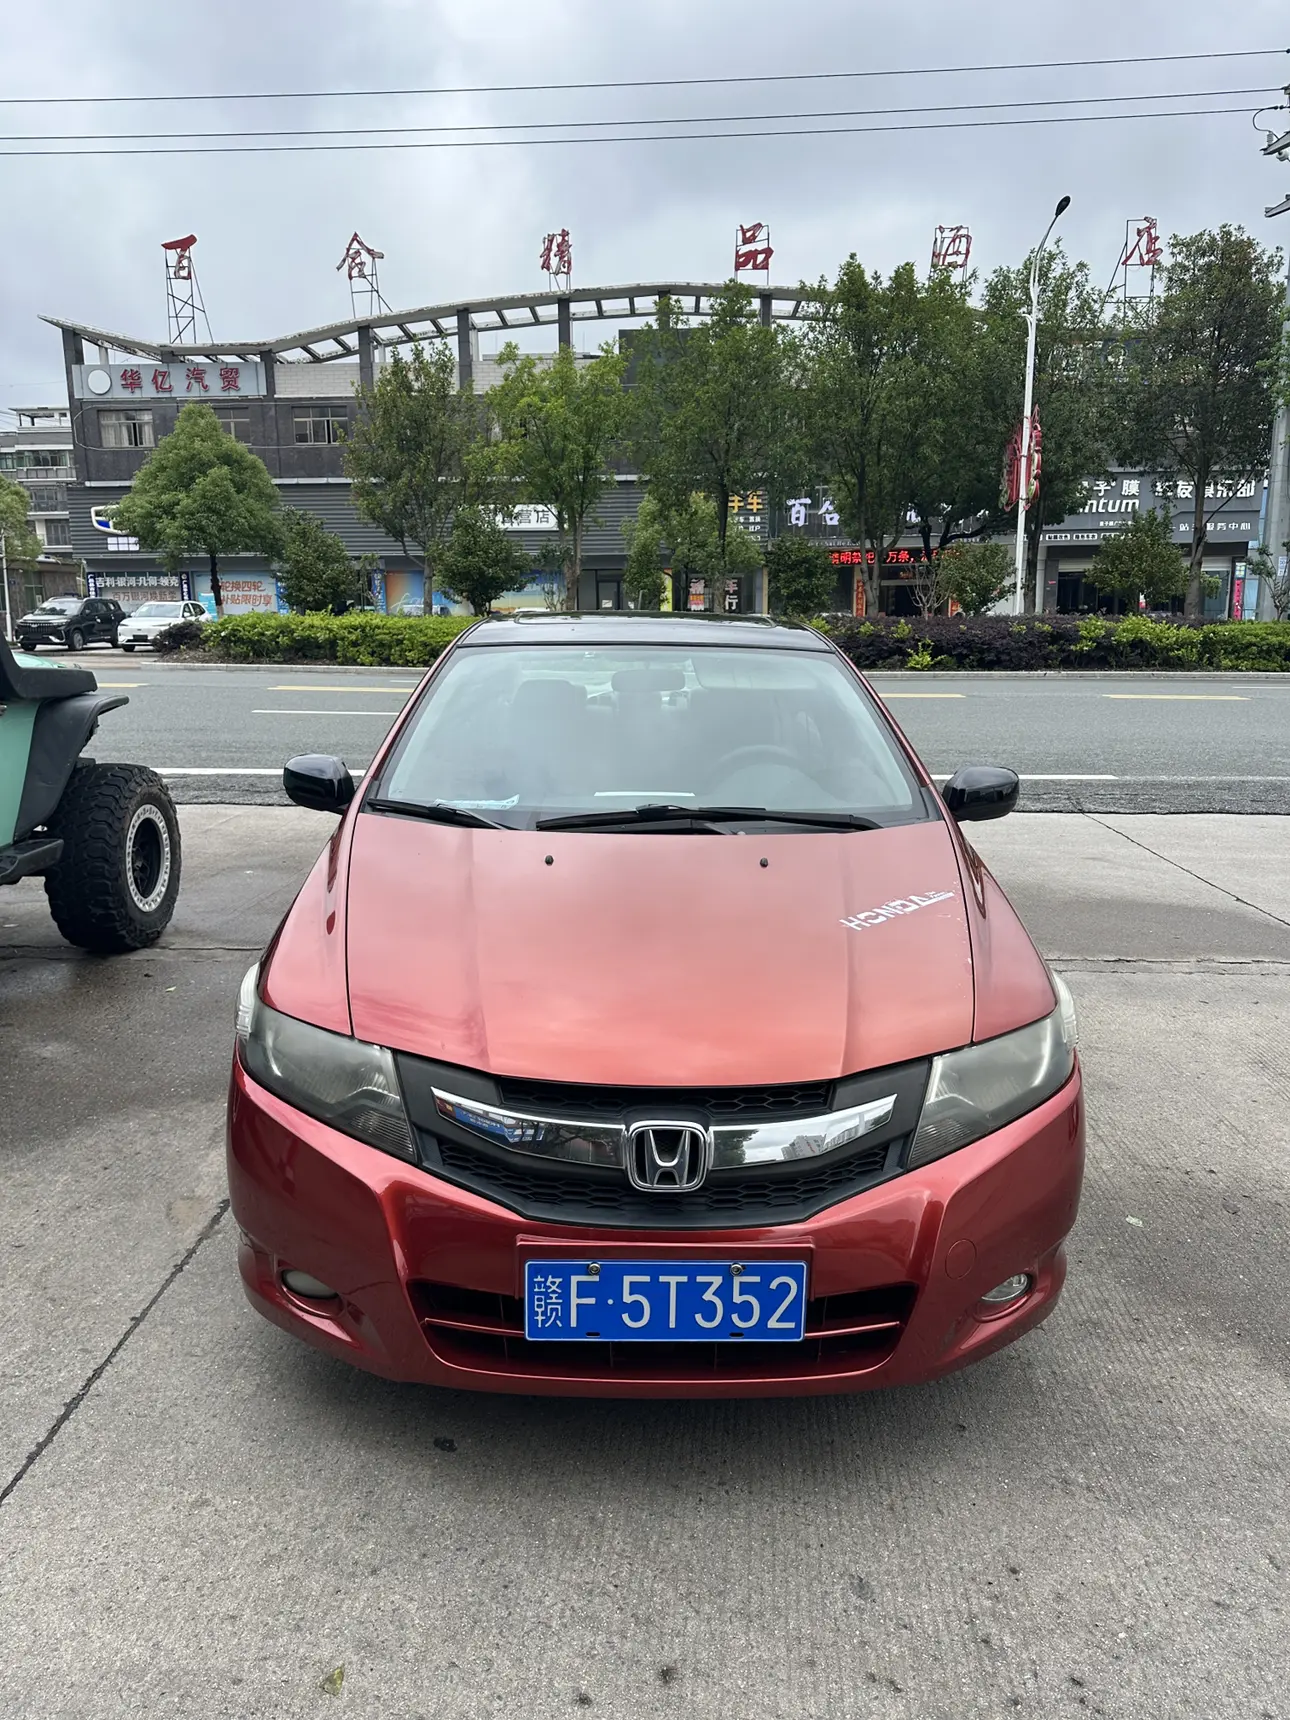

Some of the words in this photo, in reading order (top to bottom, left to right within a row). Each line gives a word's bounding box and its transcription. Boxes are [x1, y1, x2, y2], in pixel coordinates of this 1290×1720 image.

[540, 228, 572, 275] 精
[735, 222, 774, 271] 品
[1122, 216, 1163, 266] 店
[120, 367, 241, 393] 华亿汽贸
[215, 580, 266, 592] 轮换四轮
[533, 1274, 798, 1329] 赣F·5T352
